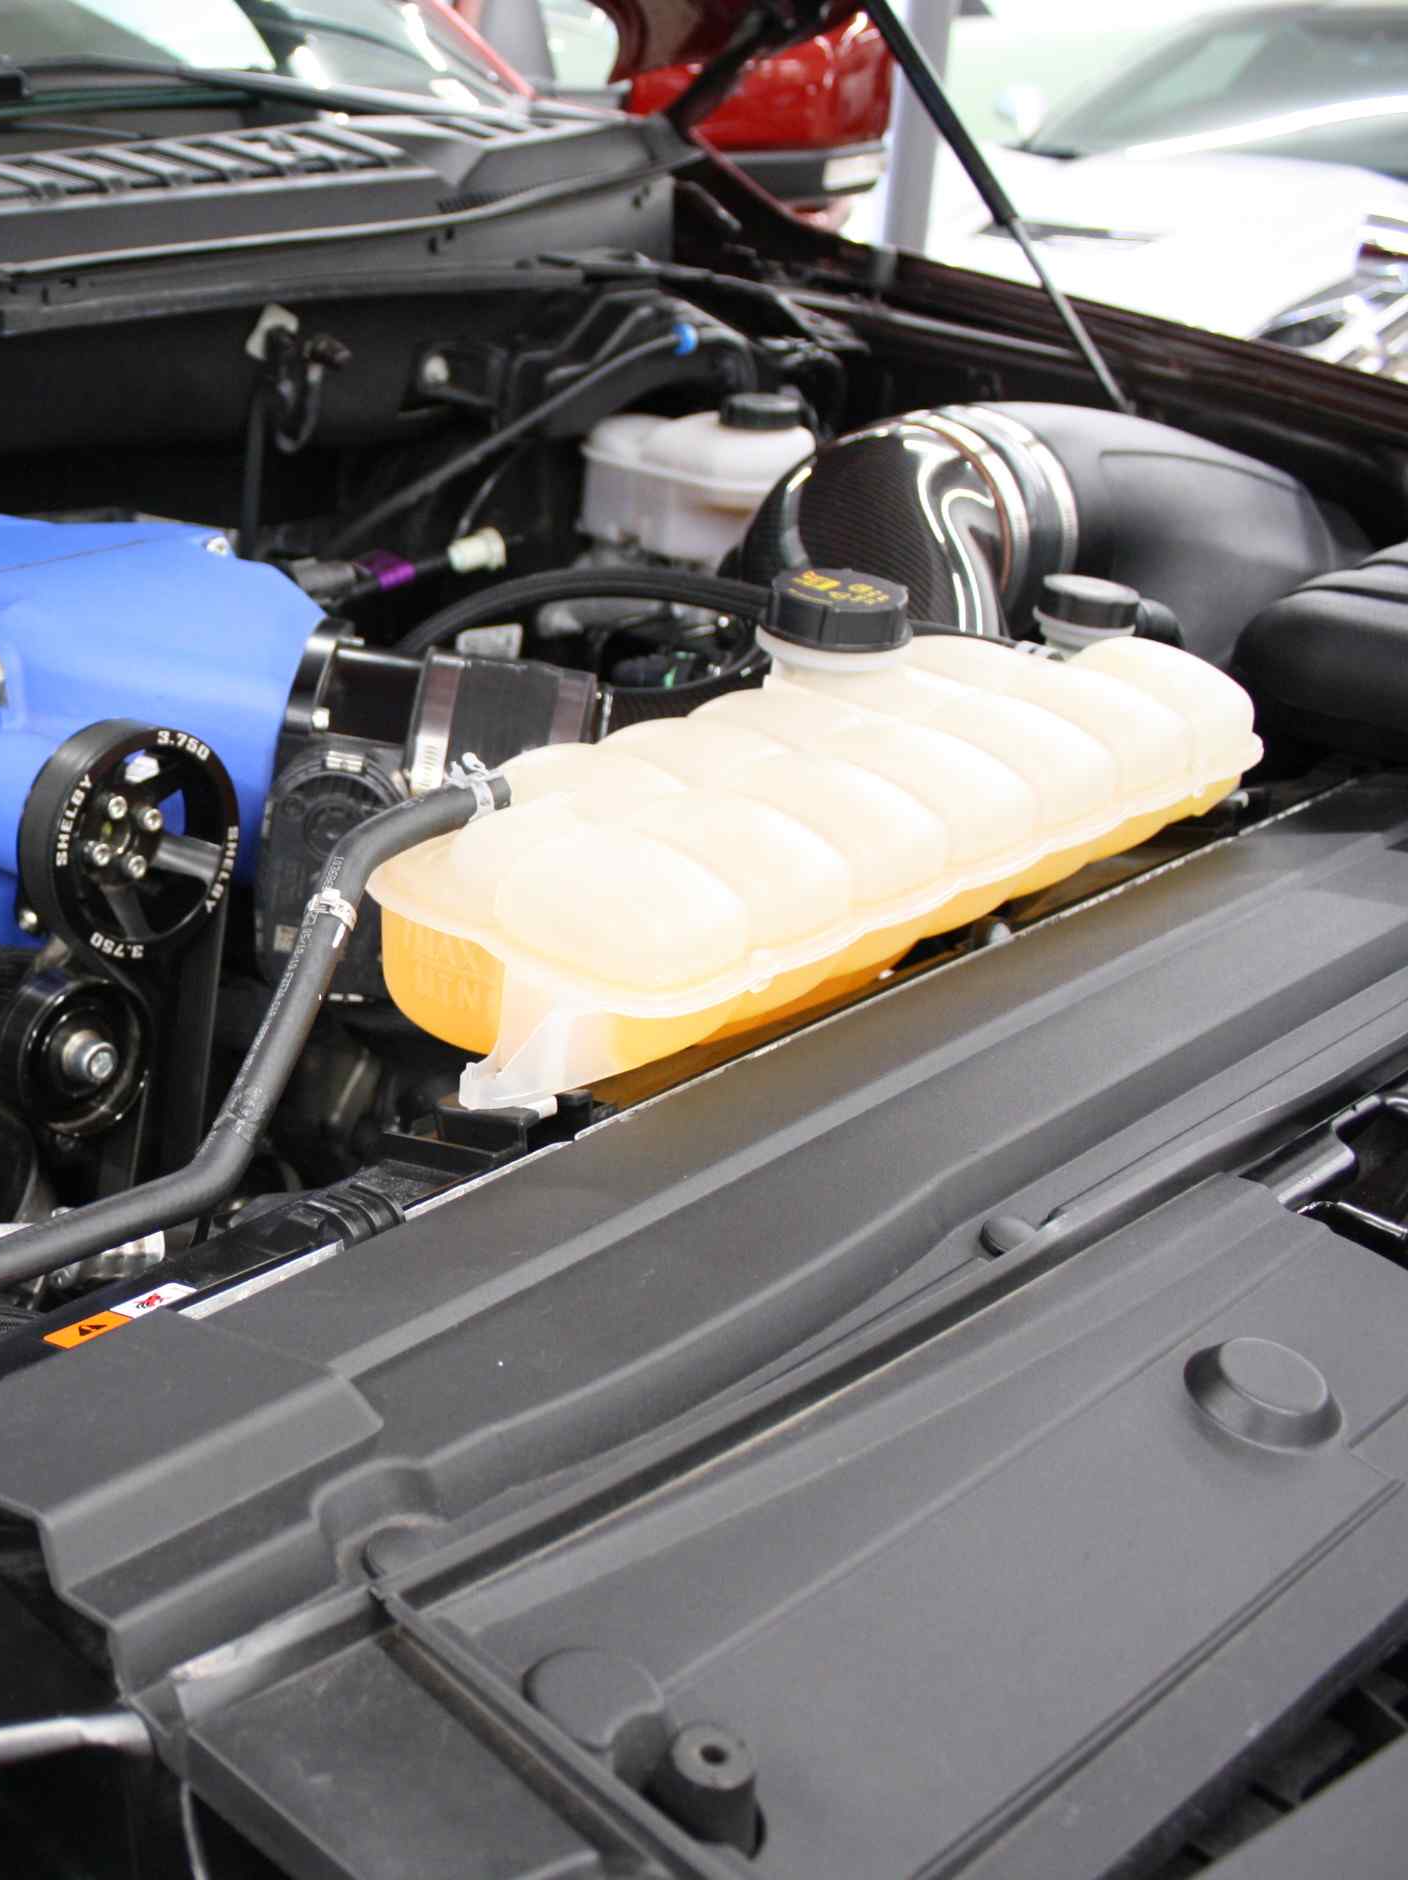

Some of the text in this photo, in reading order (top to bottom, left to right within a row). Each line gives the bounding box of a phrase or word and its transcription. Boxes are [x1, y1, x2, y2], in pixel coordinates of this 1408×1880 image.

[156, 729, 210, 761] 3.750
[55, 773, 94, 867] SHELBY
[204, 825, 240, 913] SHELBY
[89, 931, 145, 960] 3.750
